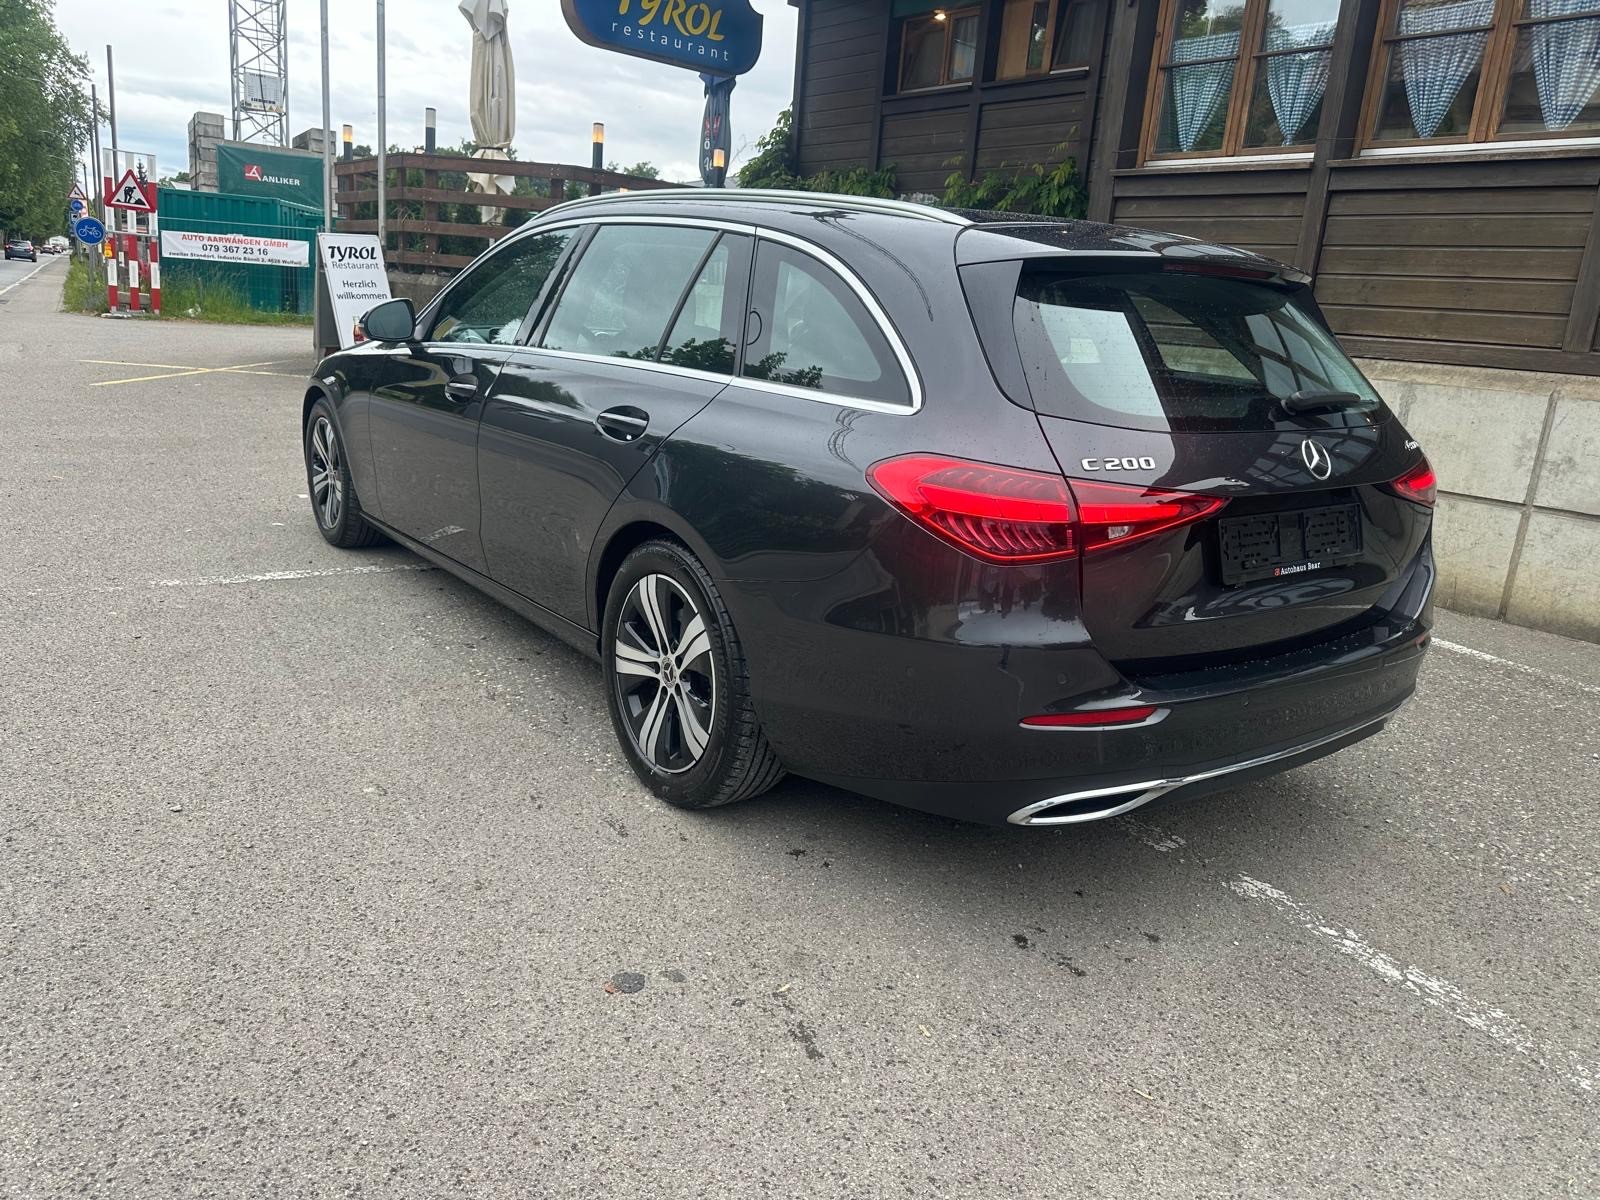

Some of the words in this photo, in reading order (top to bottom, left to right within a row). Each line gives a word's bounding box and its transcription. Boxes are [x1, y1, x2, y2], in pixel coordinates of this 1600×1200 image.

[611, 21, 729, 61] restaurant
[262, 175, 301, 186] ANLIKER
[181, 233, 205, 242] AUTO
[263, 239, 288, 248] GMBH
[201, 243, 220, 252] 079
[222, 245, 240, 254] 367
[242, 246, 254, 255] 23
[257, 248, 268, 256] 16
[328, 245, 377, 262] TYROL
[332, 261, 379, 270] Restaurant
[342, 280, 377, 288] Herzlich
[336, 292, 388, 300] willkommen
[1081, 457, 1100, 471] C
[1103, 456, 1156, 471] 200
[1280, 564, 1307, 575] Autohaus
